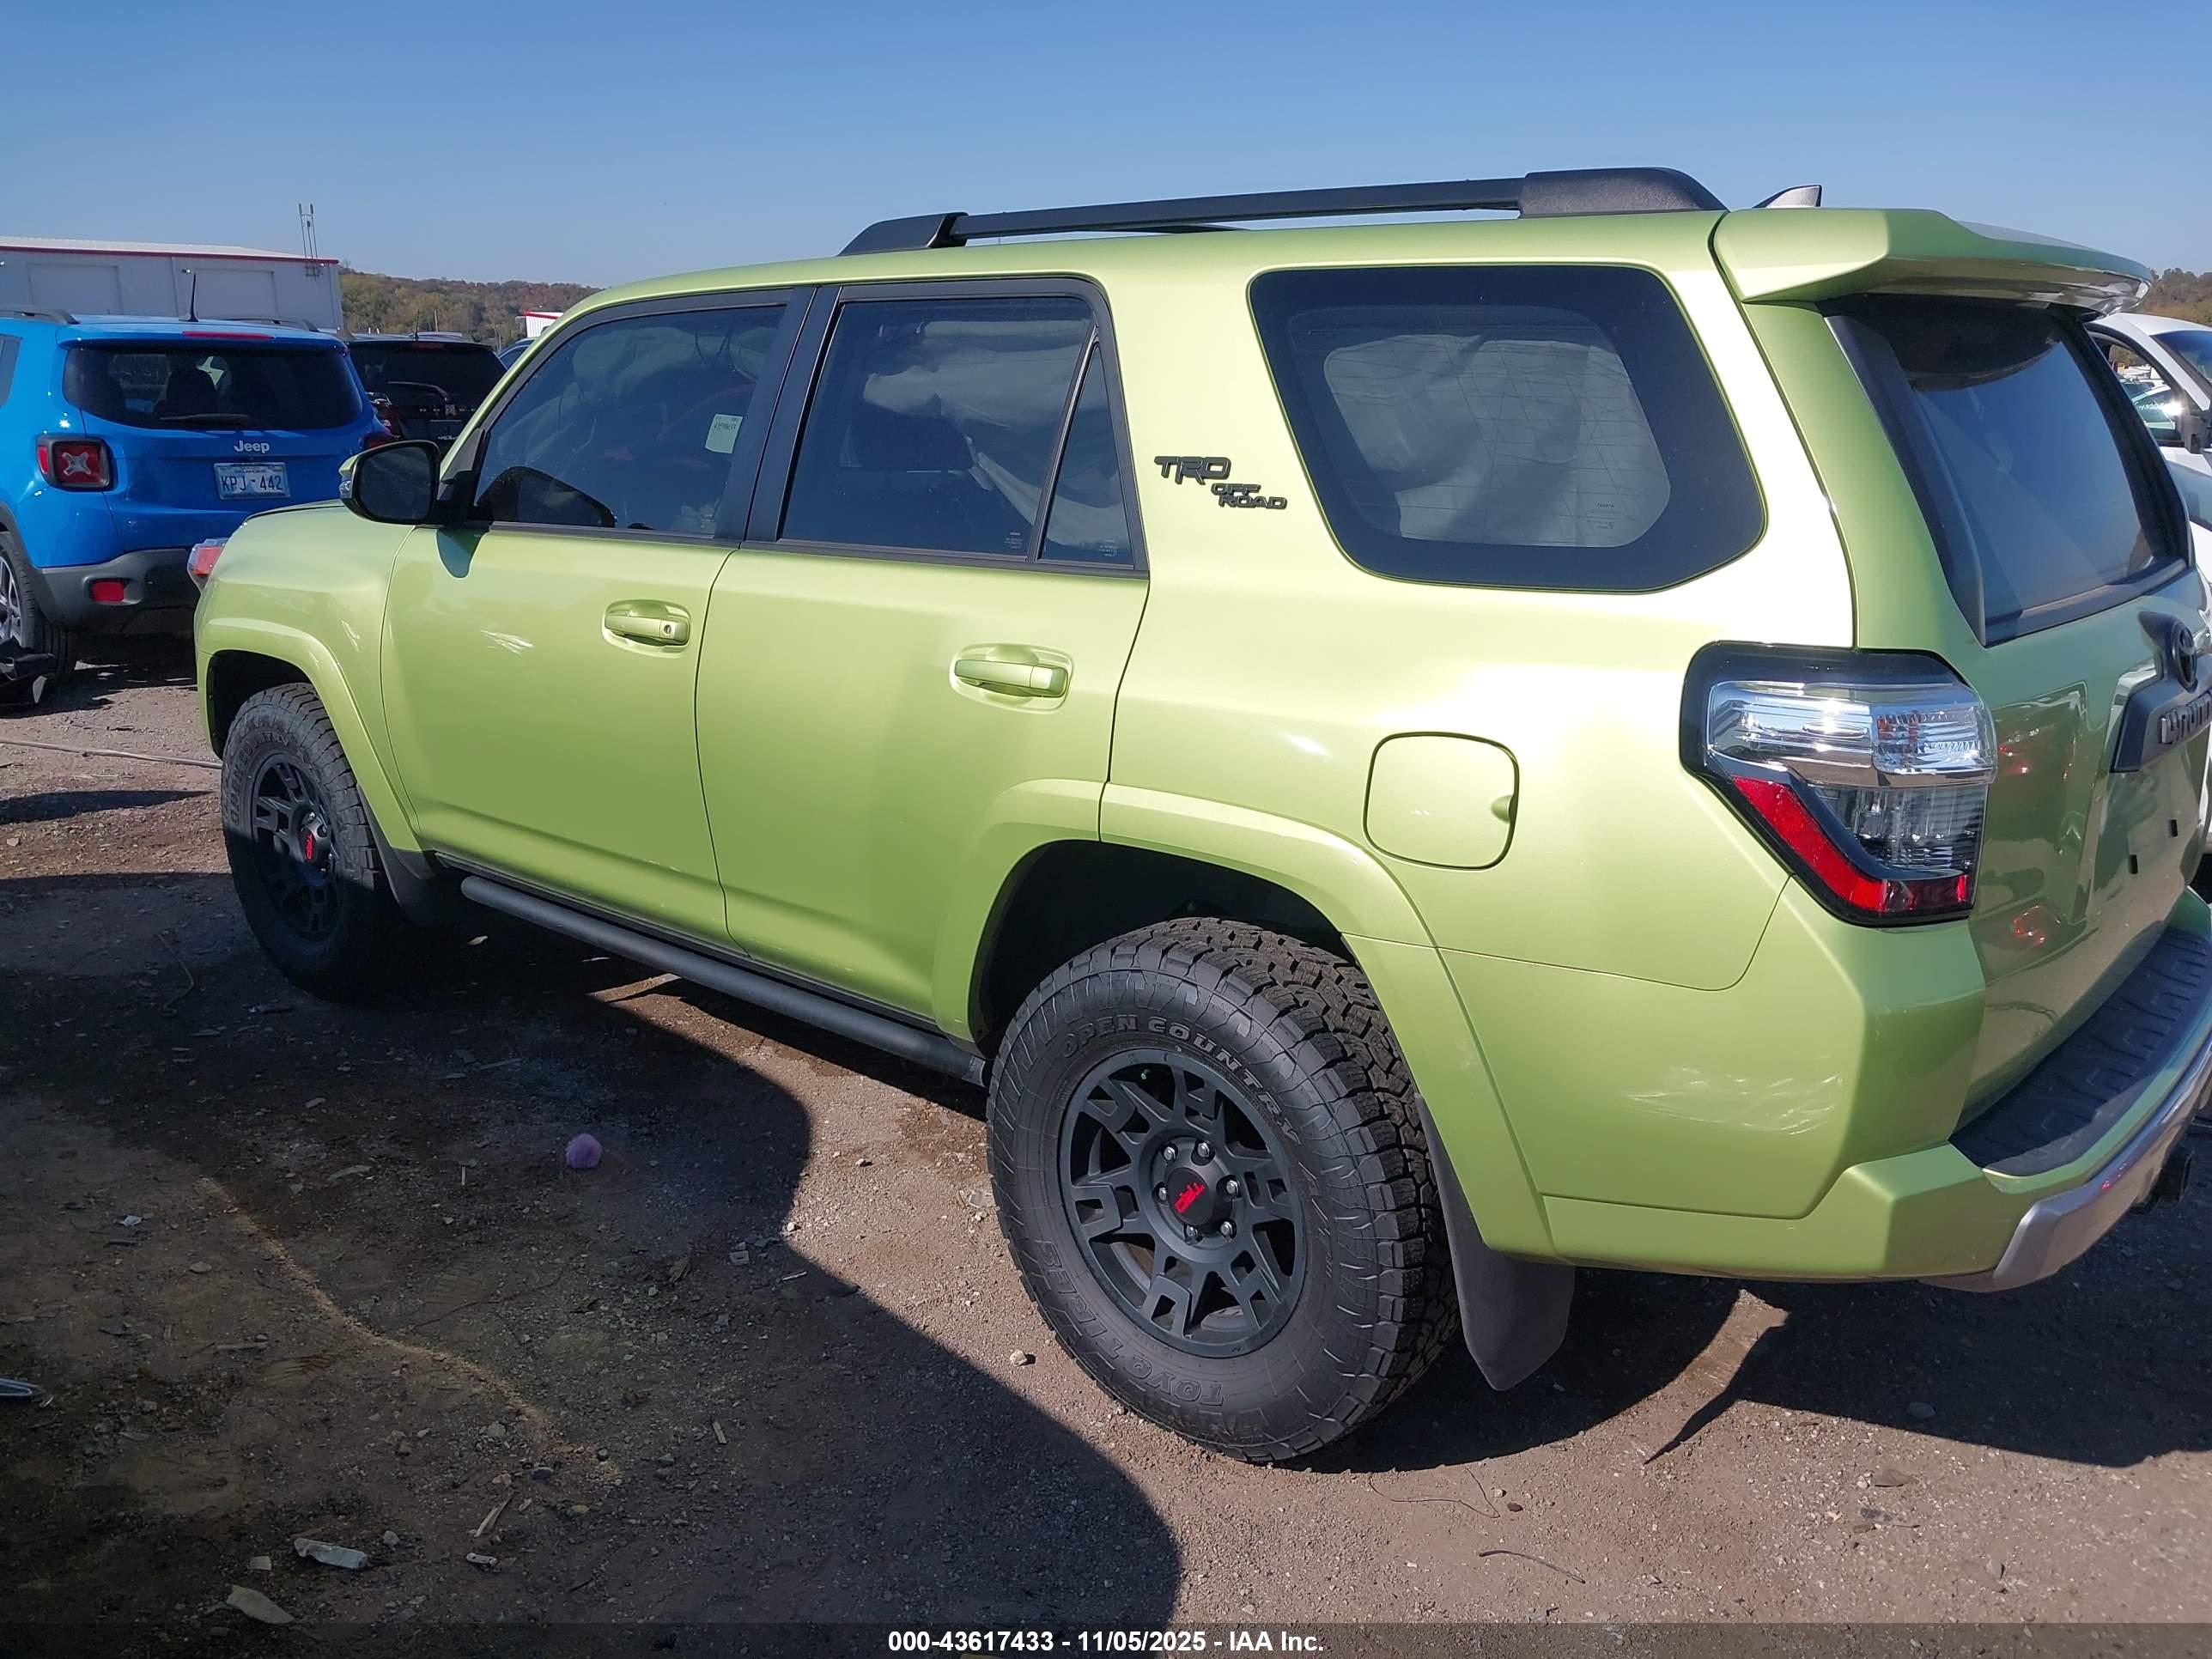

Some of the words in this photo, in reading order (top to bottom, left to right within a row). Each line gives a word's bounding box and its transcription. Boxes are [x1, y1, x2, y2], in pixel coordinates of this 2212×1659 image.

[234, 440, 270, 454] Jeep
[1153, 456, 1231, 485] TRD
[1211, 483, 1261, 495] OFF
[1218, 495, 1287, 509] ROAD
[1064, 1014, 1137, 1058] OPEN
[1148, 1016, 1302, 1146] COUNTRY
[1124, 1356, 1224, 1406] TOYO
